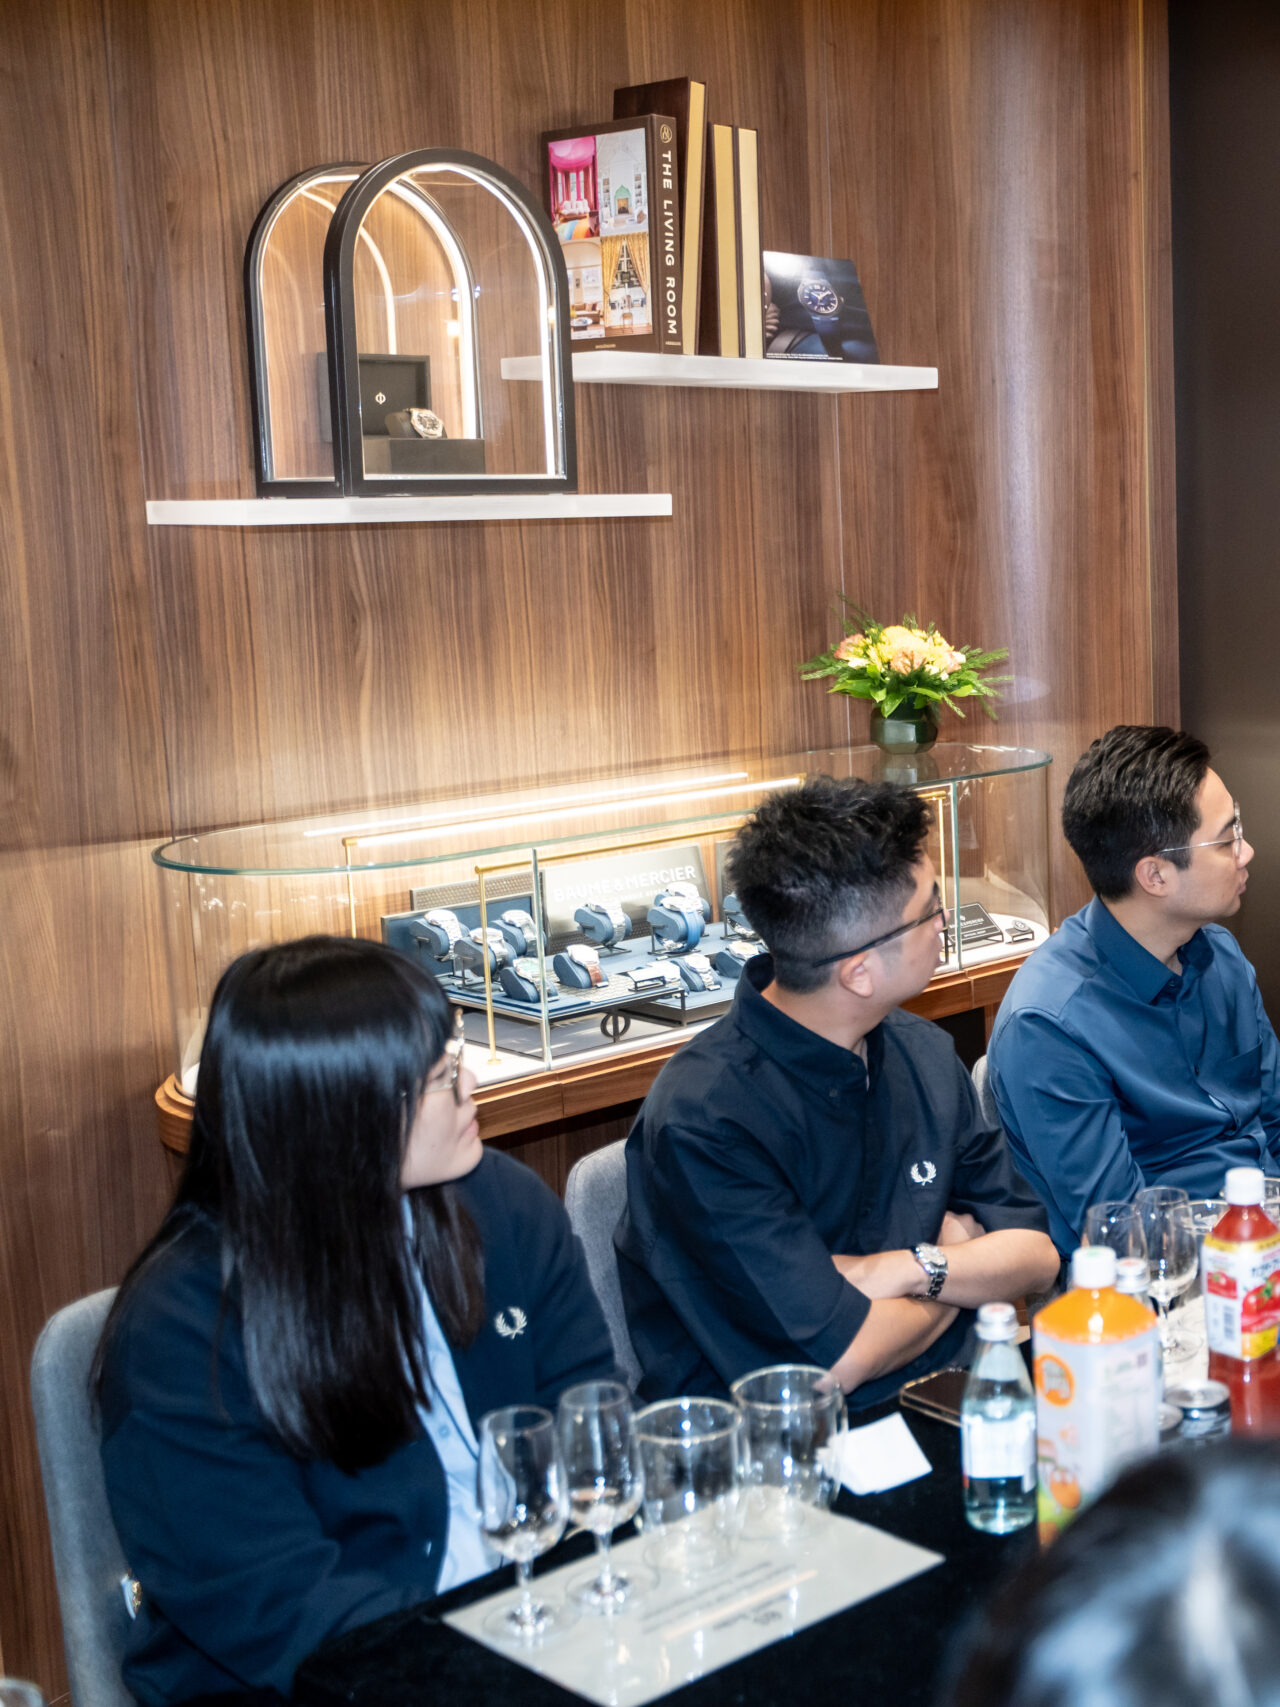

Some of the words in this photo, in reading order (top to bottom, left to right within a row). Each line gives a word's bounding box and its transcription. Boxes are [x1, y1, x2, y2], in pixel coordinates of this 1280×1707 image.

[662, 150, 673, 190] THE
[663, 200, 675, 267] LIVING
[665, 277, 678, 334] ROOM
[626, 865, 697, 890] MERCIER
